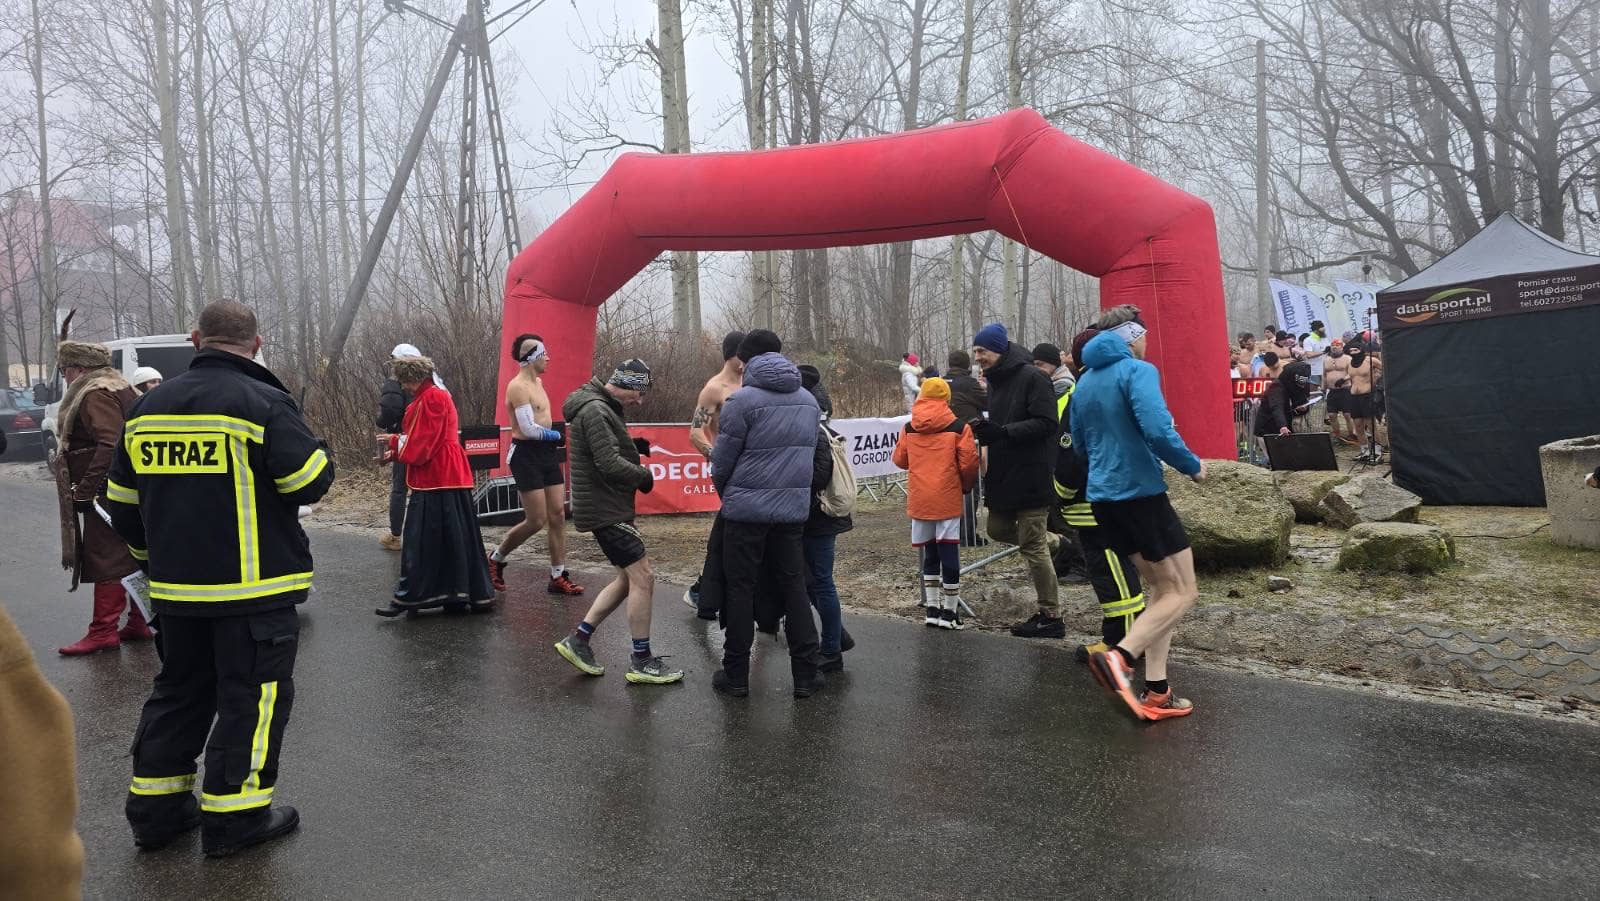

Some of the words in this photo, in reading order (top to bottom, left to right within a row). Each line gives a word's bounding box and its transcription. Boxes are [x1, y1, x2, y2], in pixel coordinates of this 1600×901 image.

[1518, 278, 1549, 288] Pomiar
[1551, 275, 1577, 284] czasu
[1396, 293, 1491, 315] datasport.pl
[1440, 309, 1462, 319] SPORT
[1464, 305, 1492, 315] TIMING
[683, 484, 716, 495] GALE
